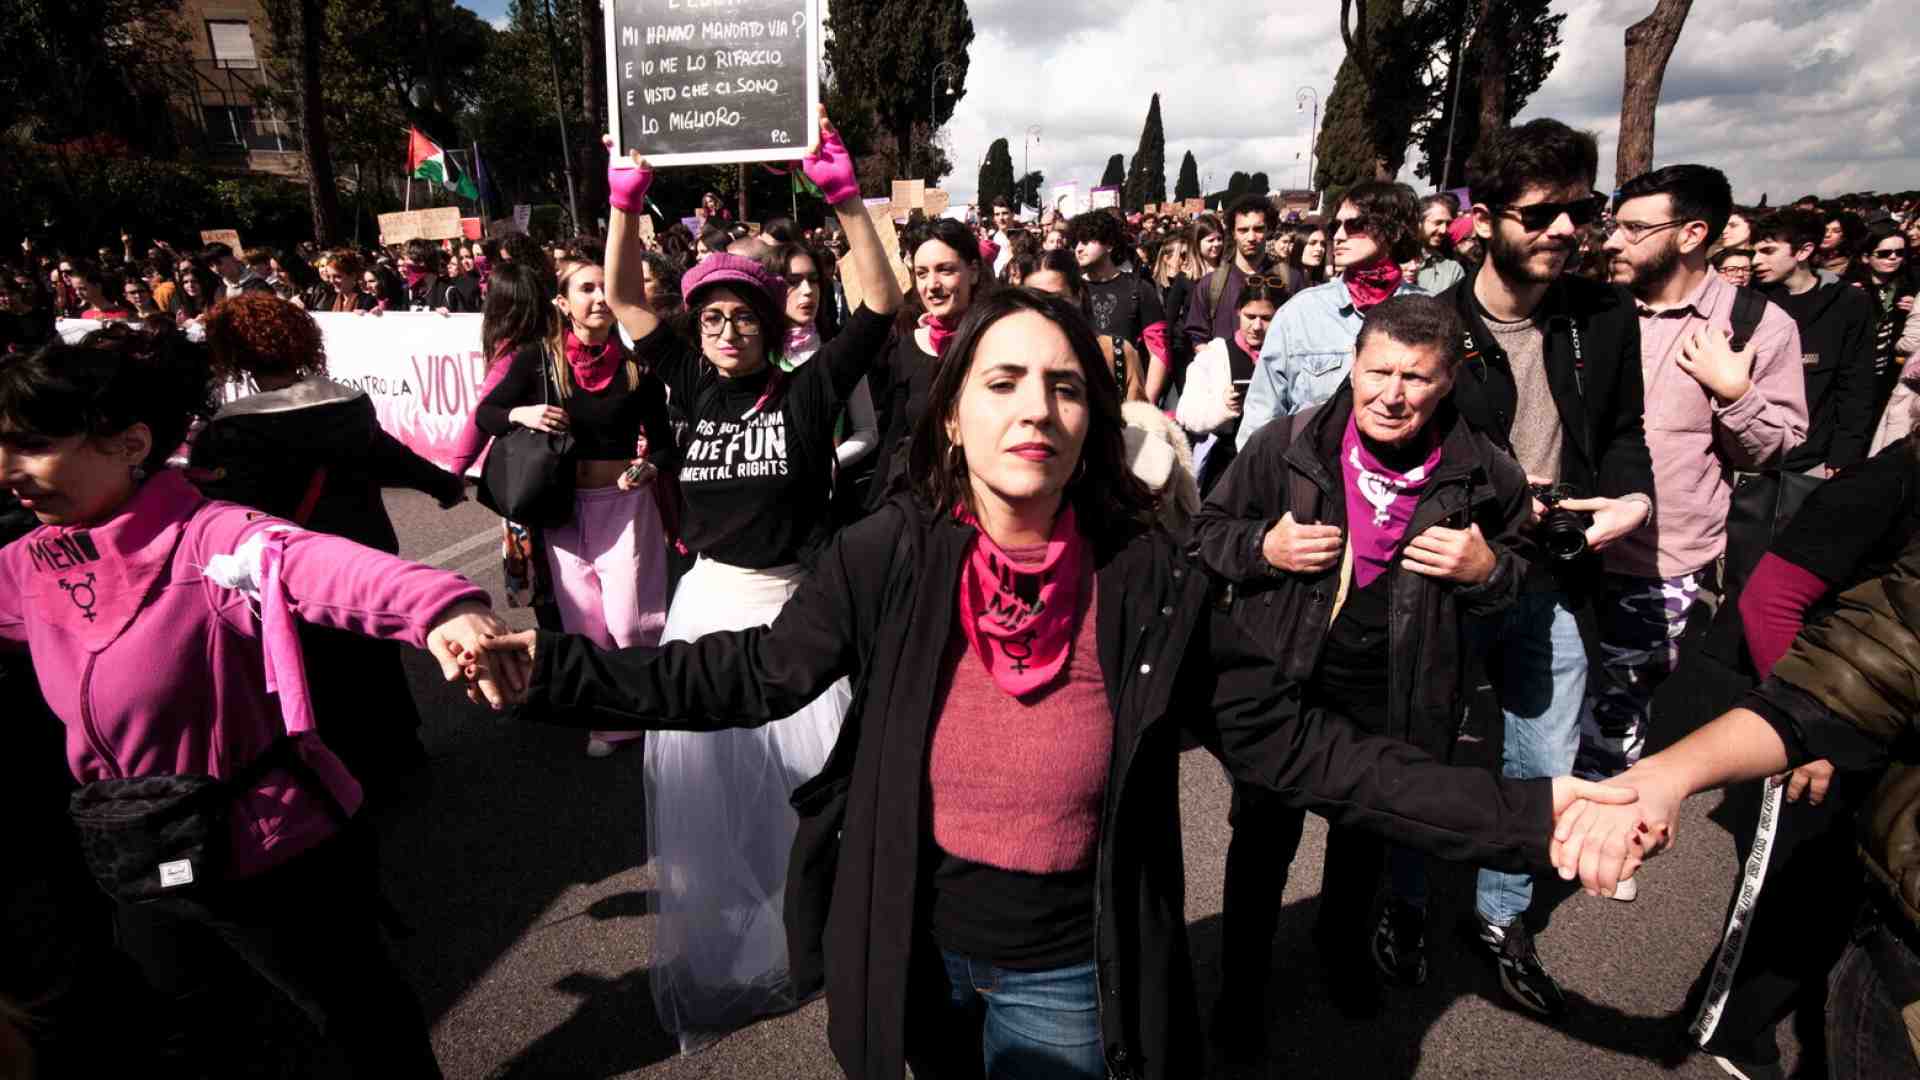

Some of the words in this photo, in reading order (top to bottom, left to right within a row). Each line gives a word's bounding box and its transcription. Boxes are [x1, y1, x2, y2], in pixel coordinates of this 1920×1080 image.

[622, 26, 639, 47] MI
[646, 23, 695, 45] HANNO
[701, 20, 765, 41] MANDATO
[625, 61, 633, 79] E
[641, 60, 654, 76] IO
[660, 56, 678, 73] ME
[686, 54, 706, 72] LO
[626, 90, 634, 107] E
[643, 86, 676, 105] VISTO
[681, 82, 709, 98] CHE
[715, 81, 731, 95] CI
[735, 77, 779, 94] SONO
[641, 114, 660, 136] LO
[669, 106, 741, 132] MIGLIORO
[391, 378, 413, 397] LA
[725, 425, 787, 465] FUN
[737, 459, 789, 478] RIGHTS
